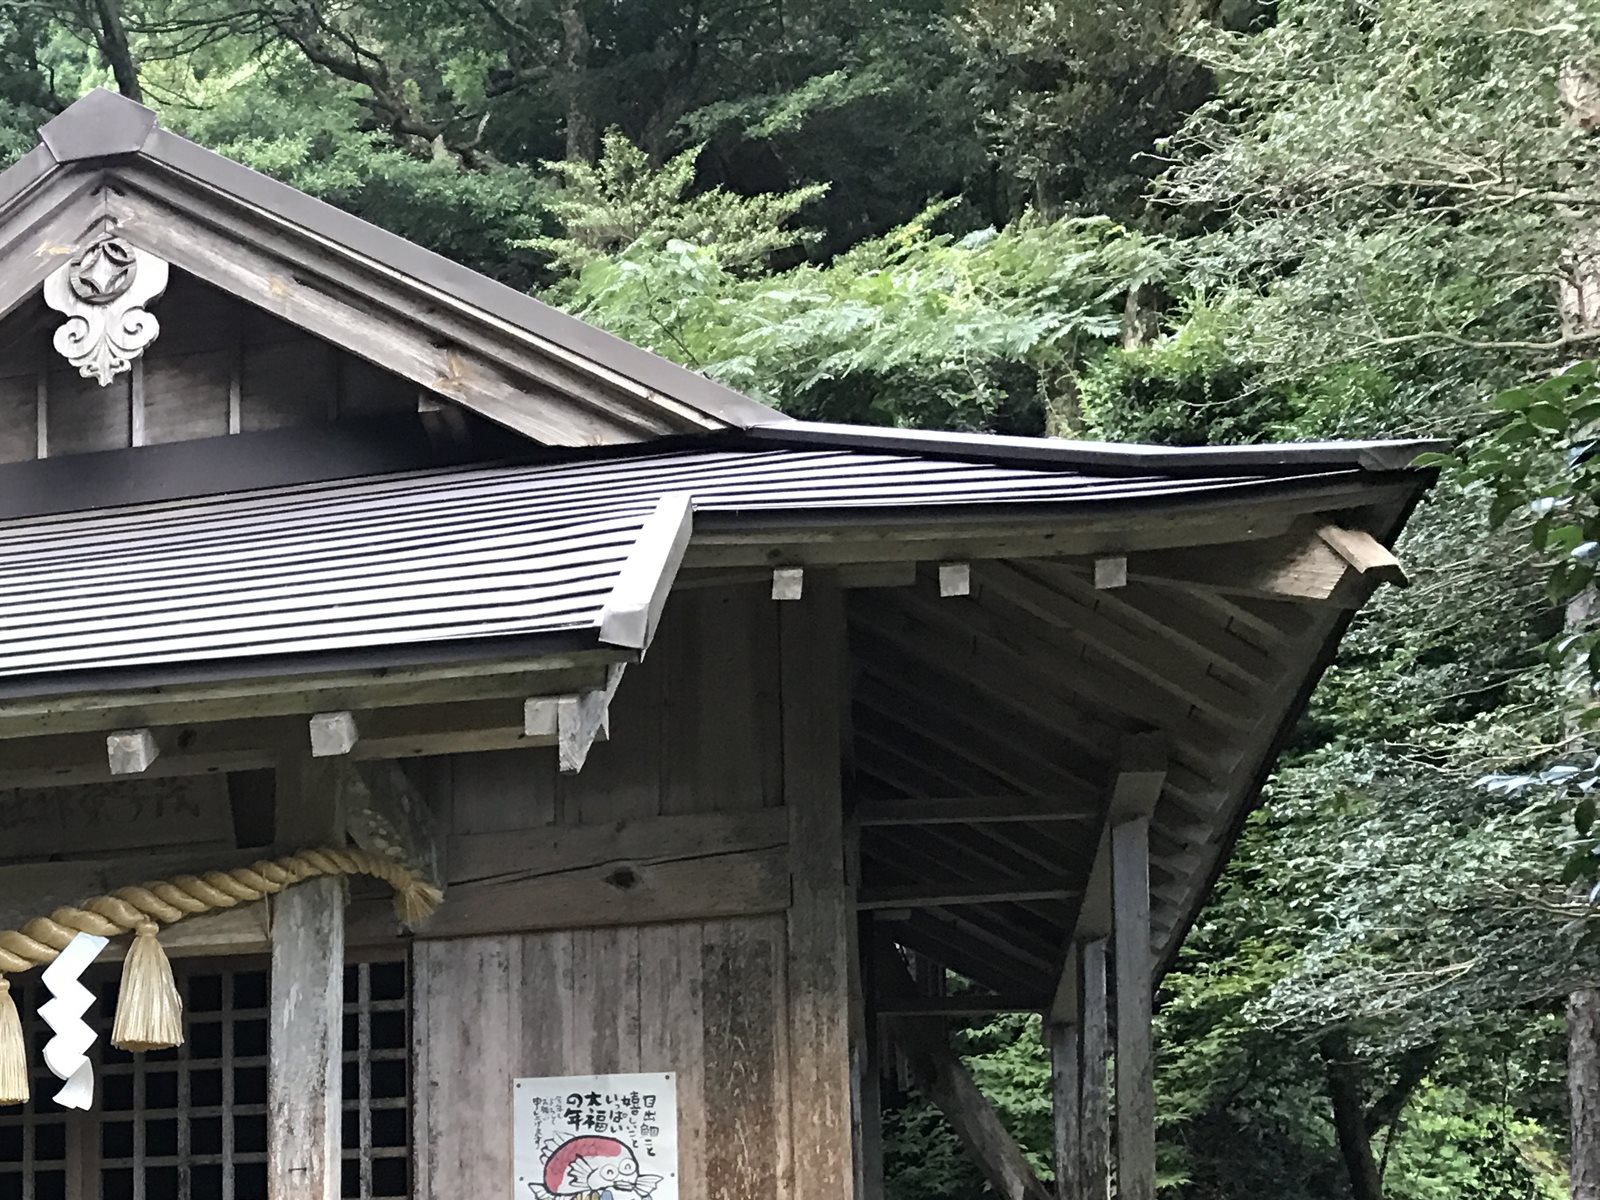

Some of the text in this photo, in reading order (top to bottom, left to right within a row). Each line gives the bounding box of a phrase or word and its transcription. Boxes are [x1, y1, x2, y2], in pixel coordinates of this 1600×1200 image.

[563, 1093, 584, 1132] の年
[605, 1093, 628, 1134] いっぱい
[621, 1091, 642, 1149] 嬉しいこと
